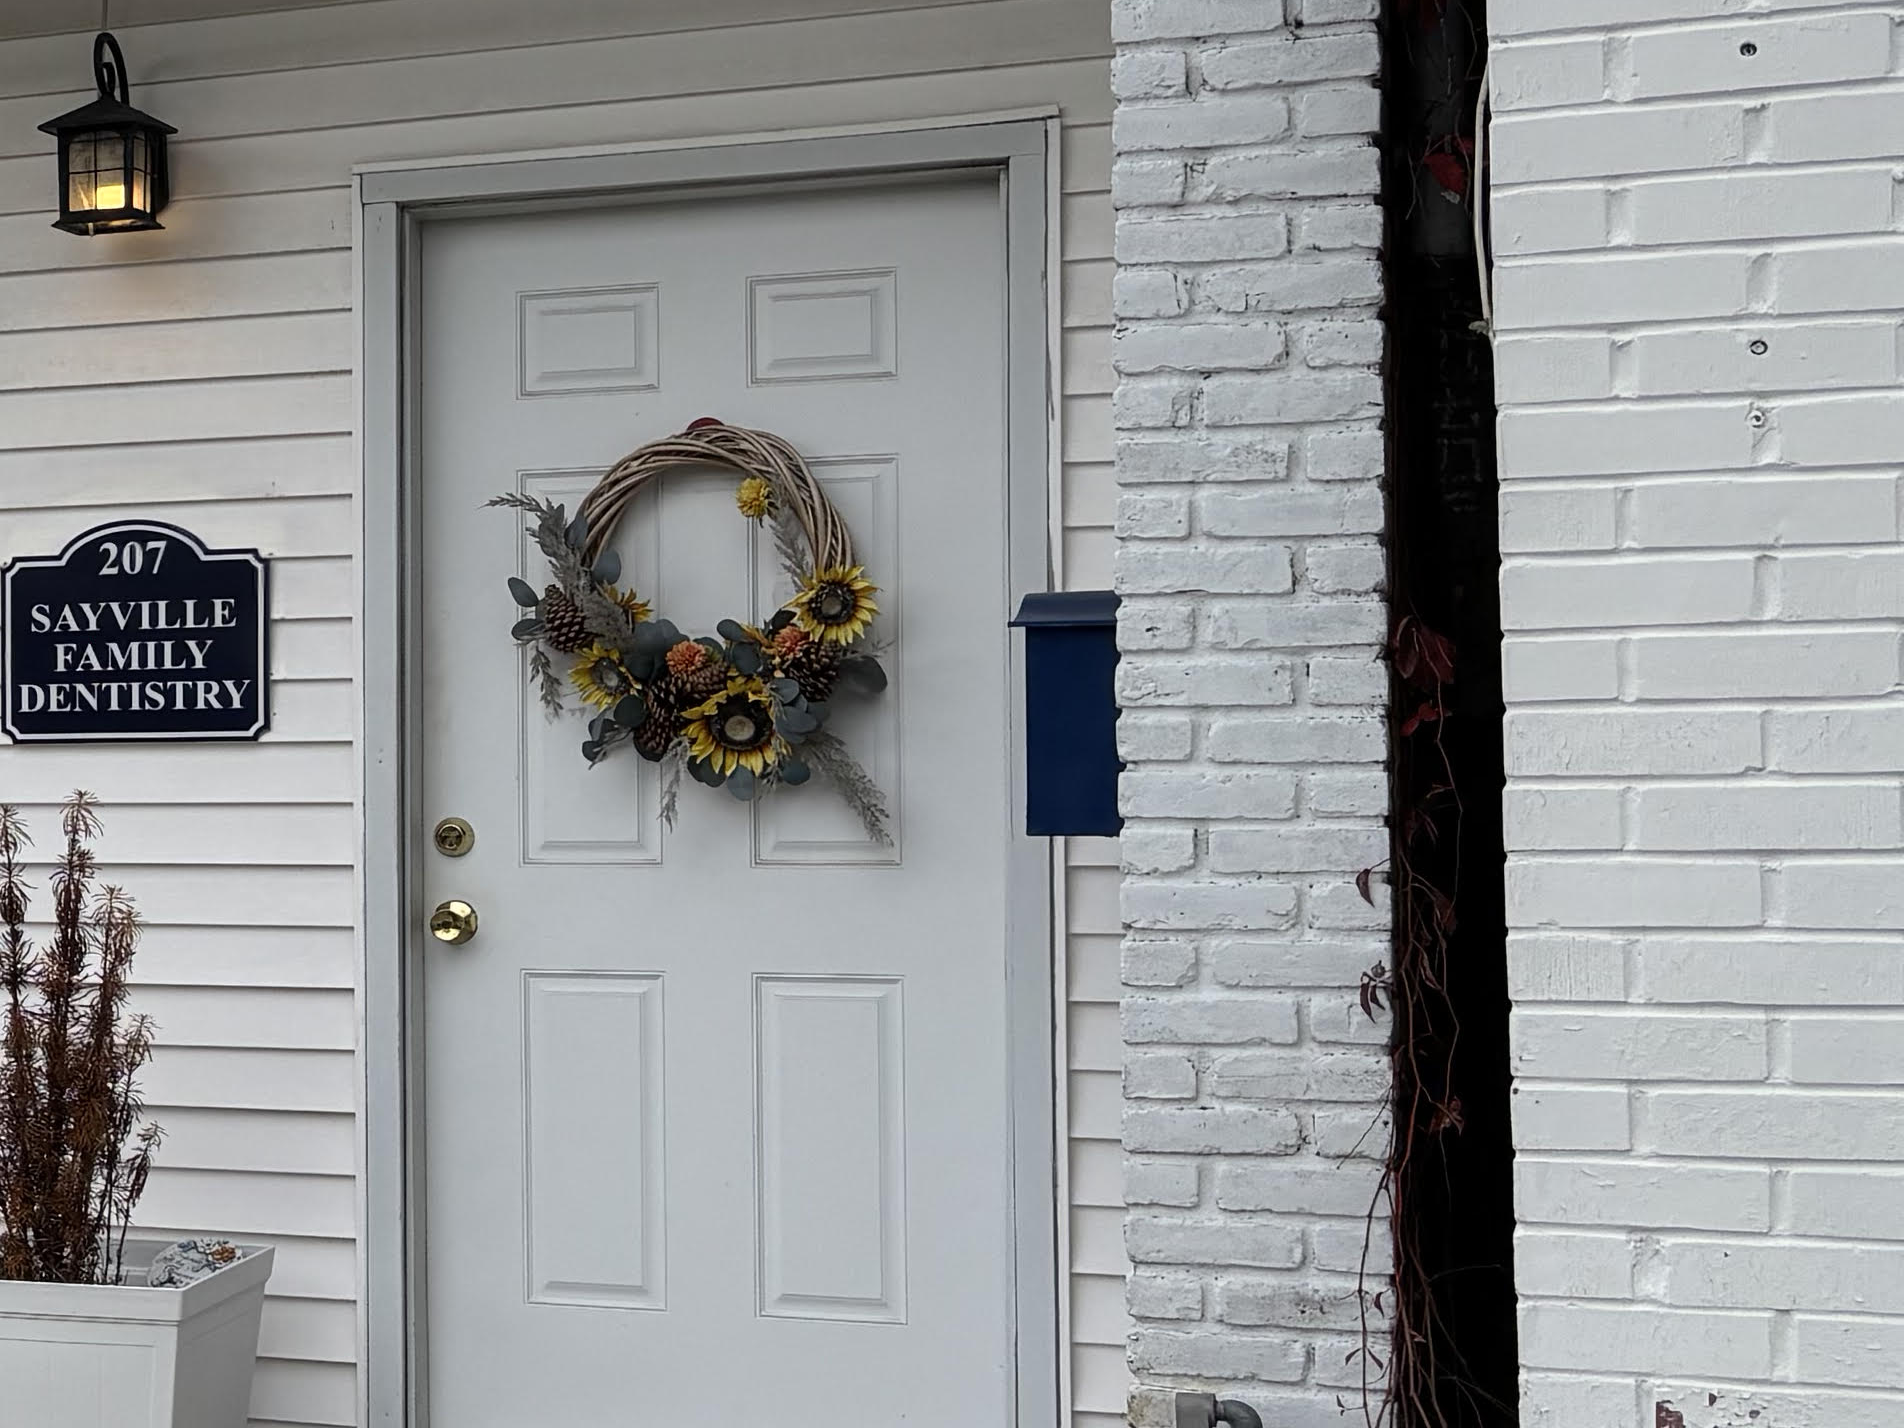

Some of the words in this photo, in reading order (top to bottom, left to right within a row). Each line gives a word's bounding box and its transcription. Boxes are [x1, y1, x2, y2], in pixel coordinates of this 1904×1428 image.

[98, 540, 168, 576] 207
[30, 598, 237, 633] SAYVILLE
[53, 639, 213, 672] FAMILY
[18, 679, 252, 713] DENTISTRY
